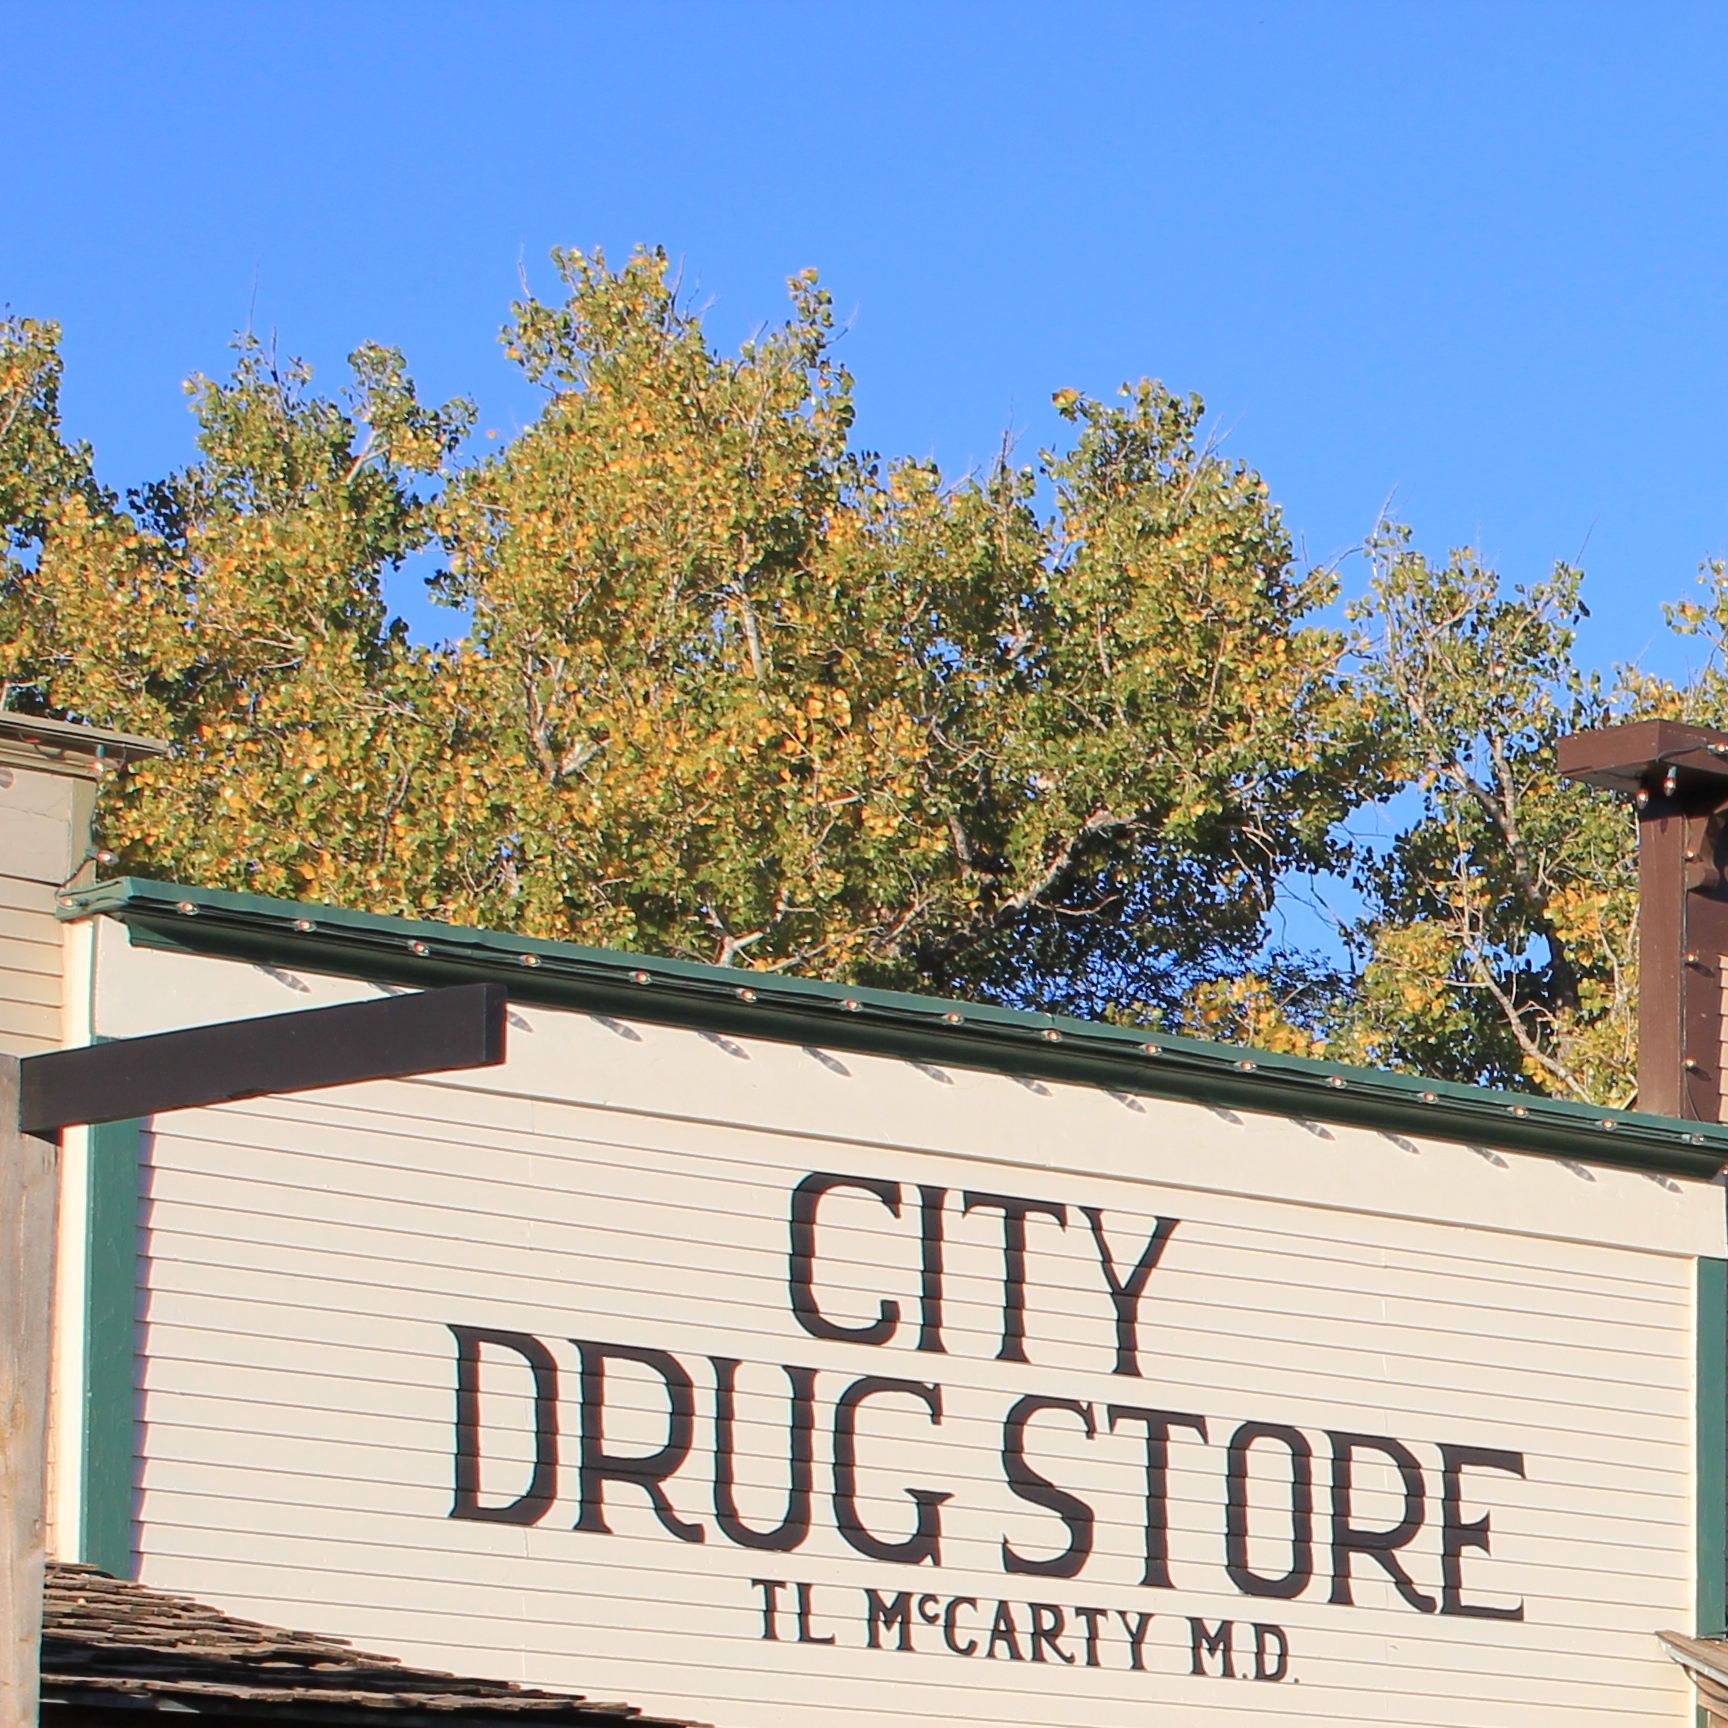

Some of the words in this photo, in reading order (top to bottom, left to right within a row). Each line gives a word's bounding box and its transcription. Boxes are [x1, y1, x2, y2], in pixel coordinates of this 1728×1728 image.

[788, 1171, 1178, 1378] CITY
[447, 1323, 953, 1567] DRUG
[1000, 1395, 1525, 1622] STORE
[751, 1578, 836, 1646] TL
[1188, 1616, 1300, 1685] M.D.
